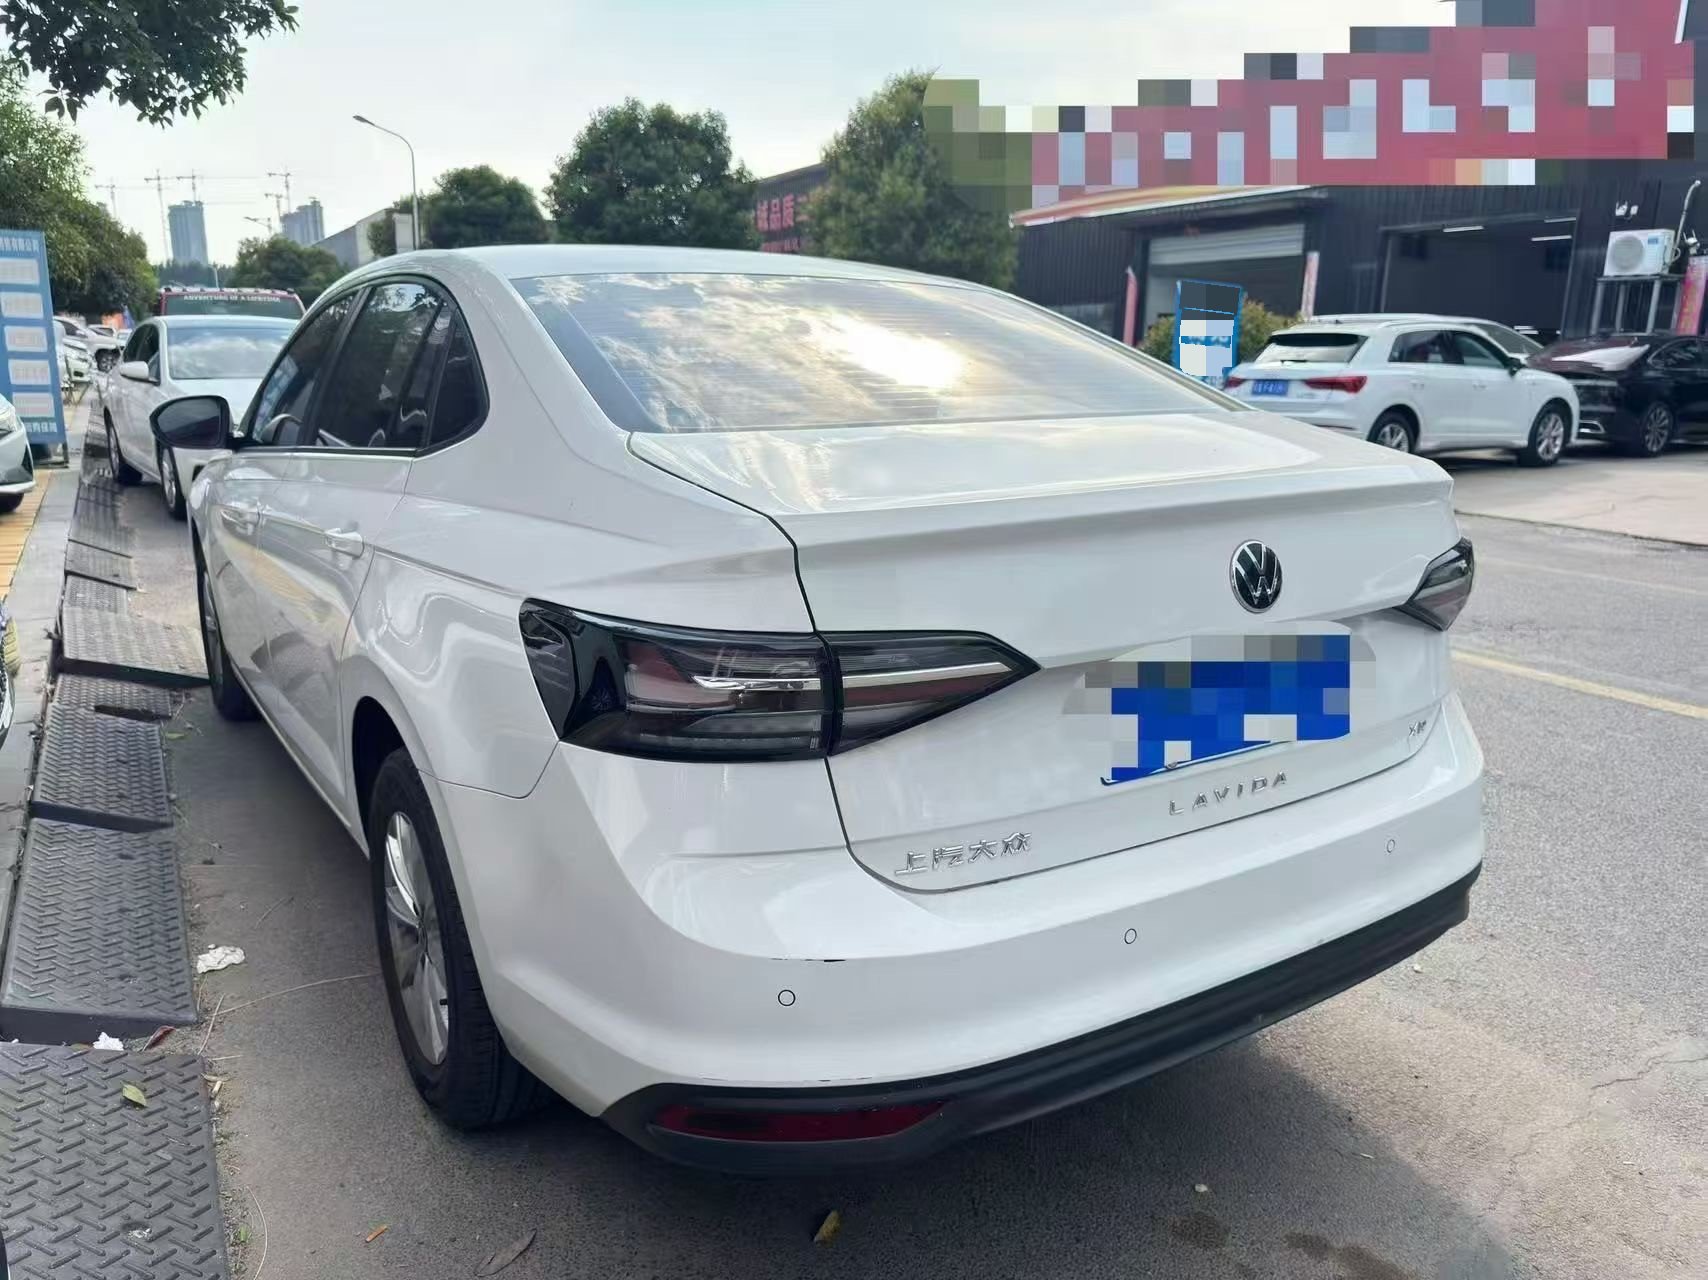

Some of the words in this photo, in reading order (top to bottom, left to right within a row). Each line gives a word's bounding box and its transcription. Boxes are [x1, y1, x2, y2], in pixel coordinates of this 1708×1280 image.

[1168, 771, 1288, 816] LAVIDA
[894, 832, 1032, 875] 上汽大众
